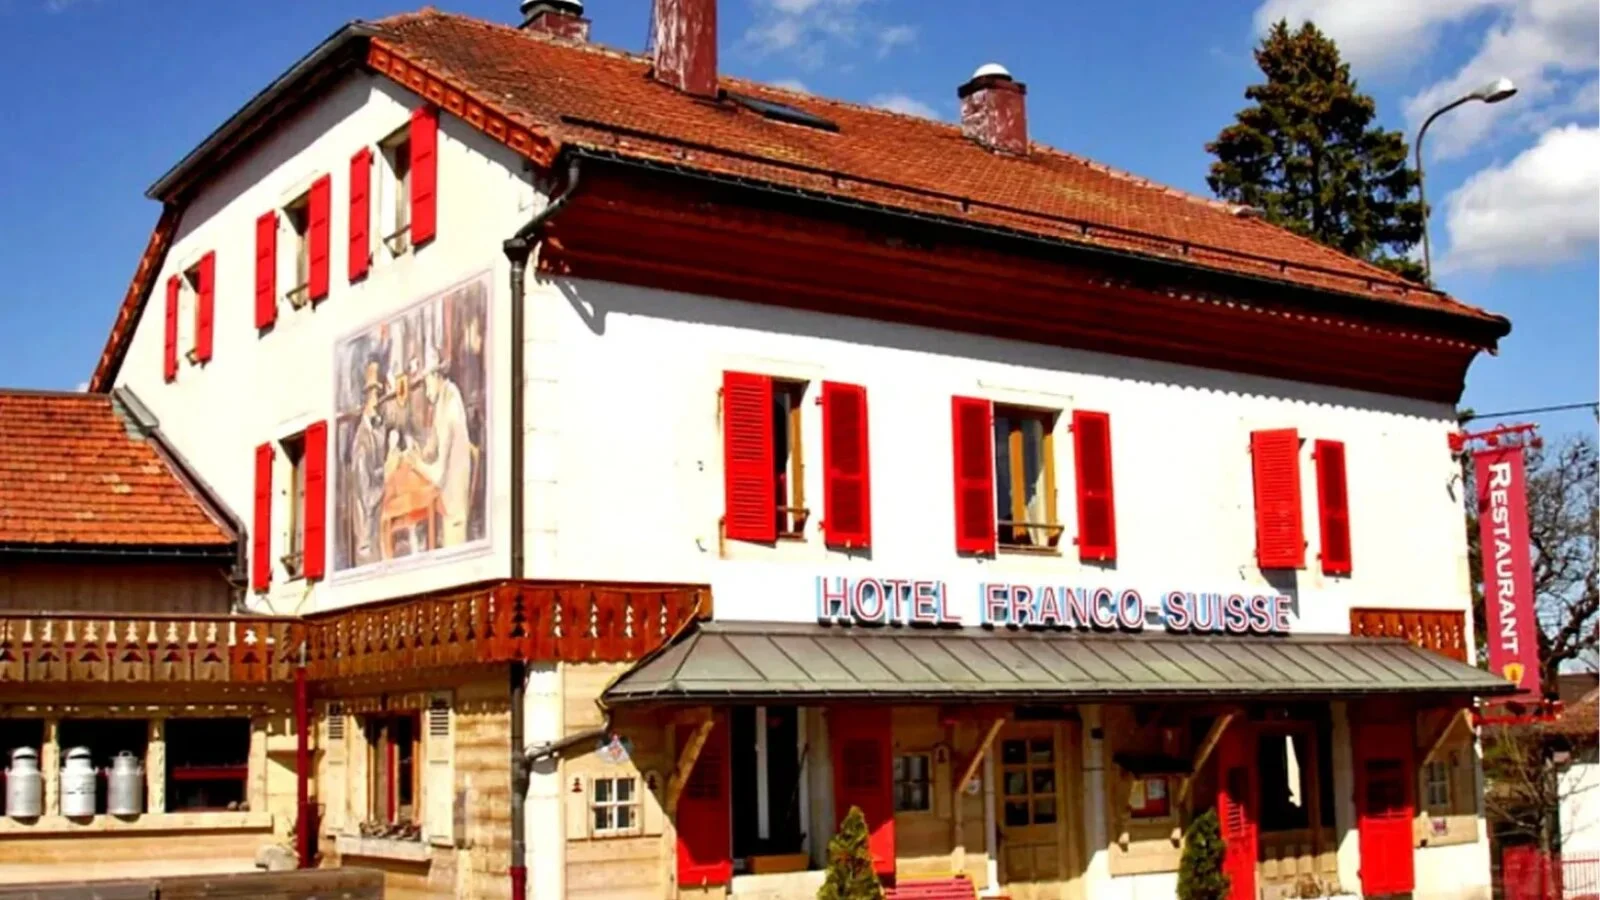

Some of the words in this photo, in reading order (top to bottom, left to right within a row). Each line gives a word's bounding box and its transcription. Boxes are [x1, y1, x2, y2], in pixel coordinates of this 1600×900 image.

[818, 576, 962, 624] HOTEL
[981, 582, 1292, 633] FRANCO-SUISSE
[1488, 461, 1519, 655] RESTAURANT
